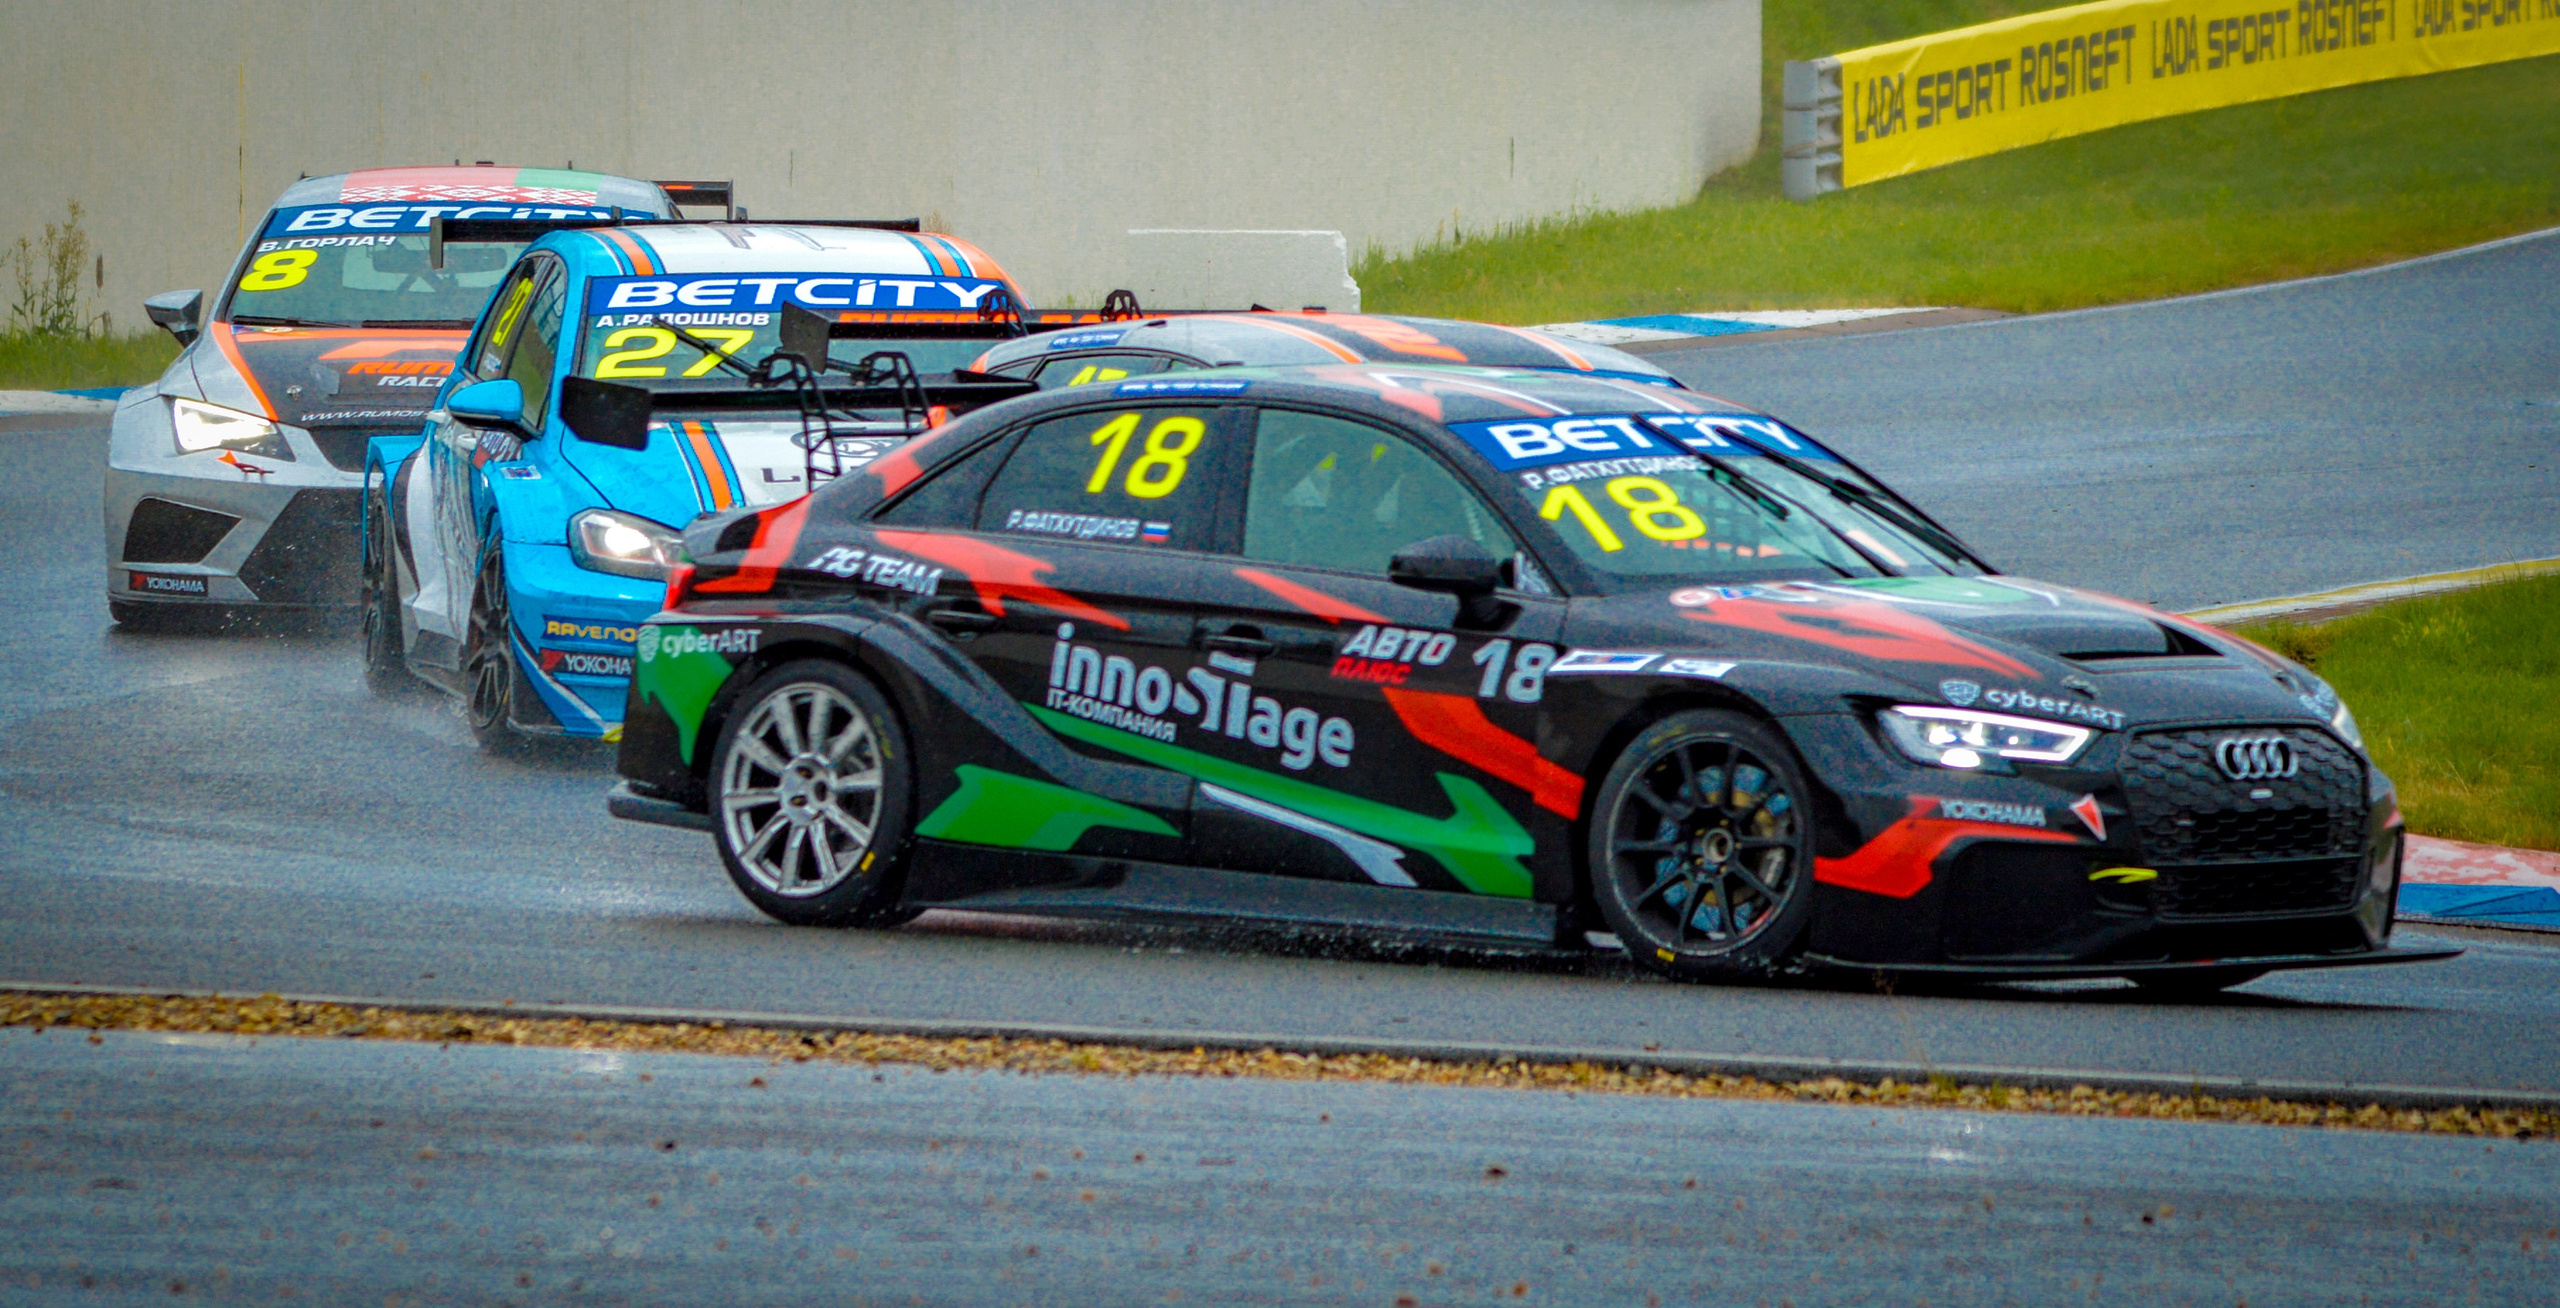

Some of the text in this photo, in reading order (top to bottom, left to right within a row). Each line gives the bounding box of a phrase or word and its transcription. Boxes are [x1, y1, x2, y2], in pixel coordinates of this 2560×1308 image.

[1854, 72, 1907, 144] LADA
[1917, 58, 2012, 129] SPORT
[2020, 24, 2136, 106] ROSNEFT
[2152, 15, 2199, 79] LADA
[2208, 10, 2290, 70] SPORT
[258, 235, 396, 252] В.ГОРЛАЧ
[239, 249, 318, 292] 8
[607, 277, 998, 308] BETCITY
[594, 327, 755, 379] 27
[1086, 412, 1206, 498] 18
[1538, 475, 1707, 552] 18
[147, 577, 204, 592] YOKOHAMA
[863, 555, 944, 596] TEAM
[661, 629, 762, 657] cyberART
[1341, 625, 1457, 666] АВТО
[1472, 638, 1558, 703] 18
[1985, 689, 2125, 729] cyberART
[1940, 799, 2046, 826] YOKOHAMA
